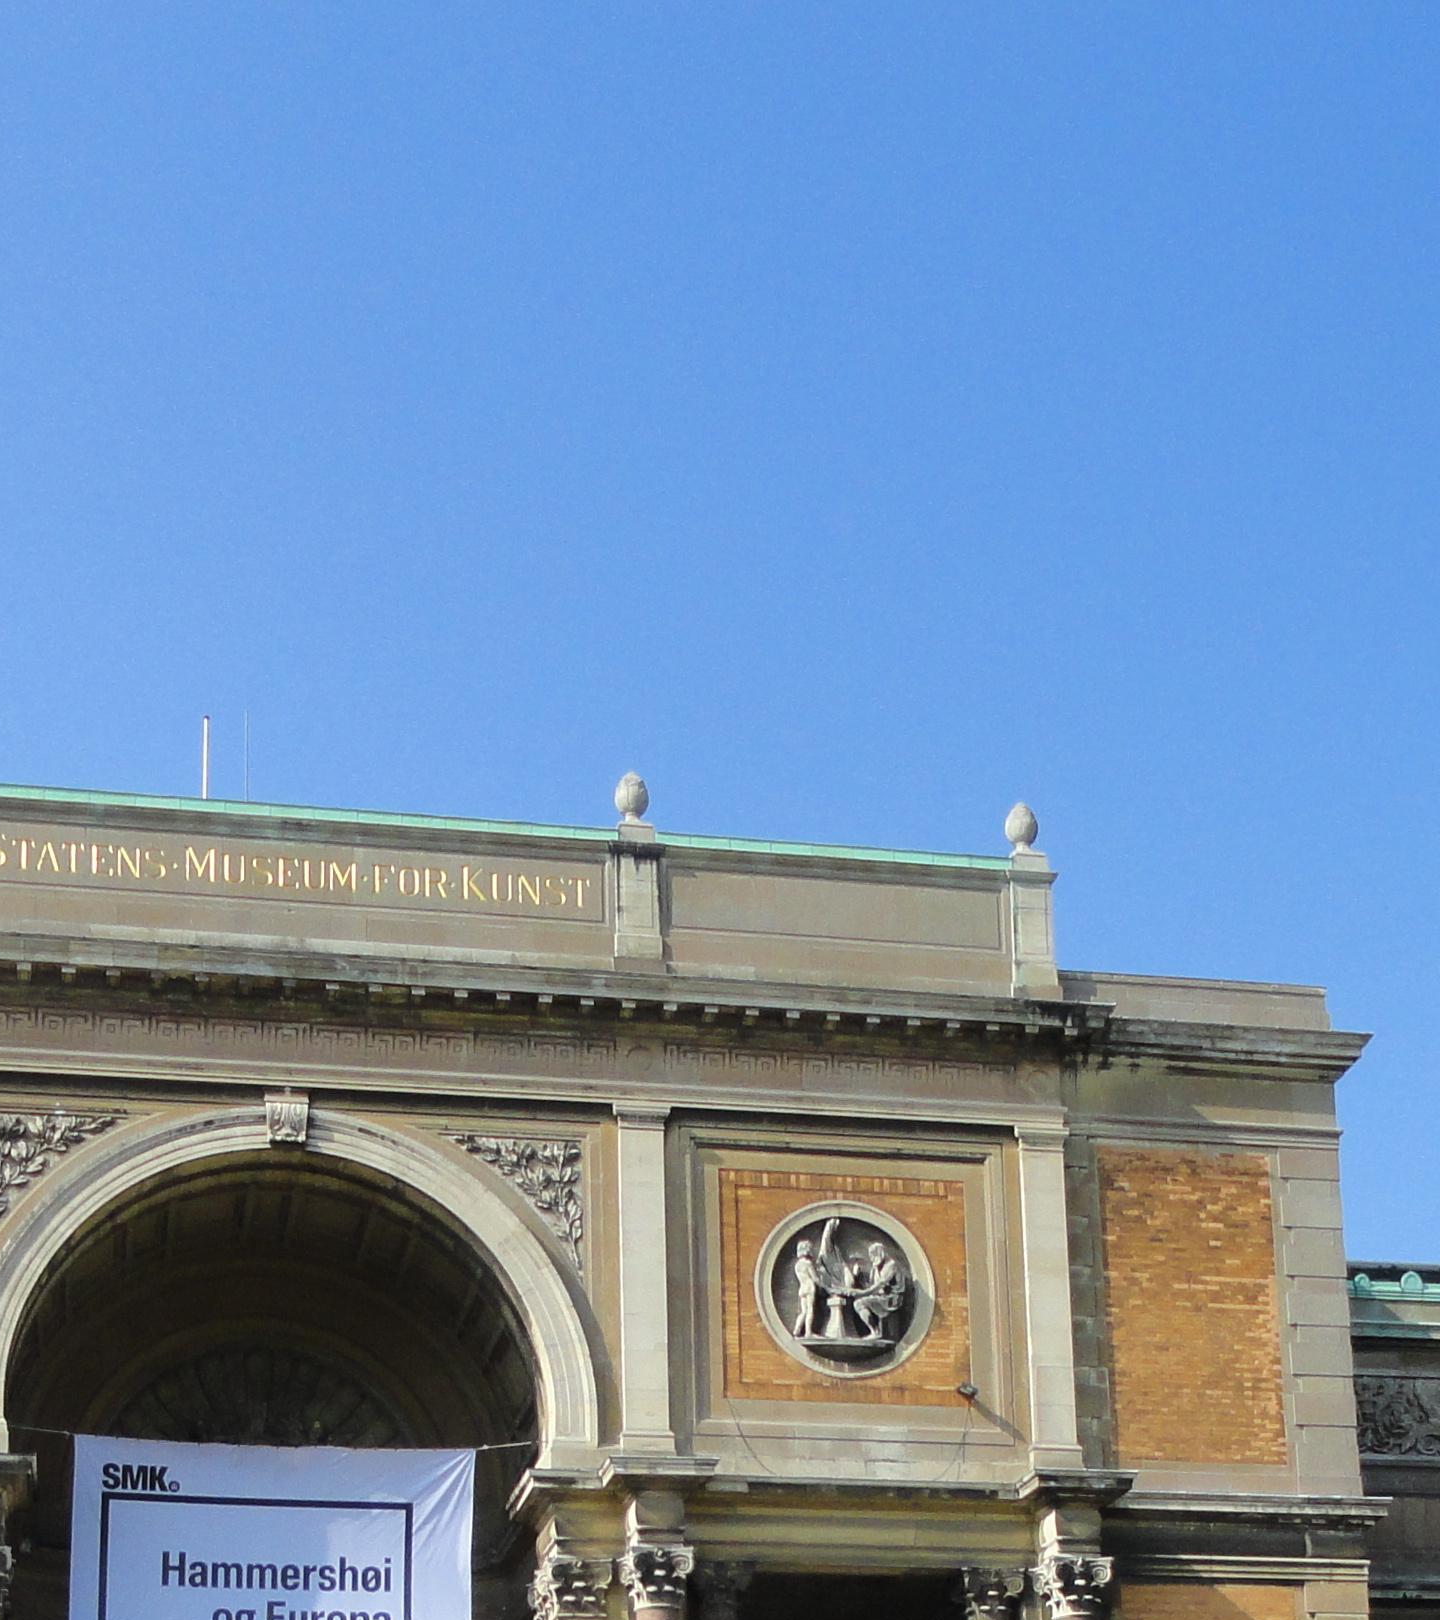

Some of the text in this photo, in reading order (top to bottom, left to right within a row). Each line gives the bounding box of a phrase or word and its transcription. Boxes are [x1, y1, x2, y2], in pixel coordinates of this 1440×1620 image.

[184, 845, 358, 893] MUSEUM
[371, 863, 448, 899] FOR
[460, 864, 591, 909] KUNST
[101, 1462, 169, 1492] SMK
[160, 1551, 392, 1593] Hammershøi
